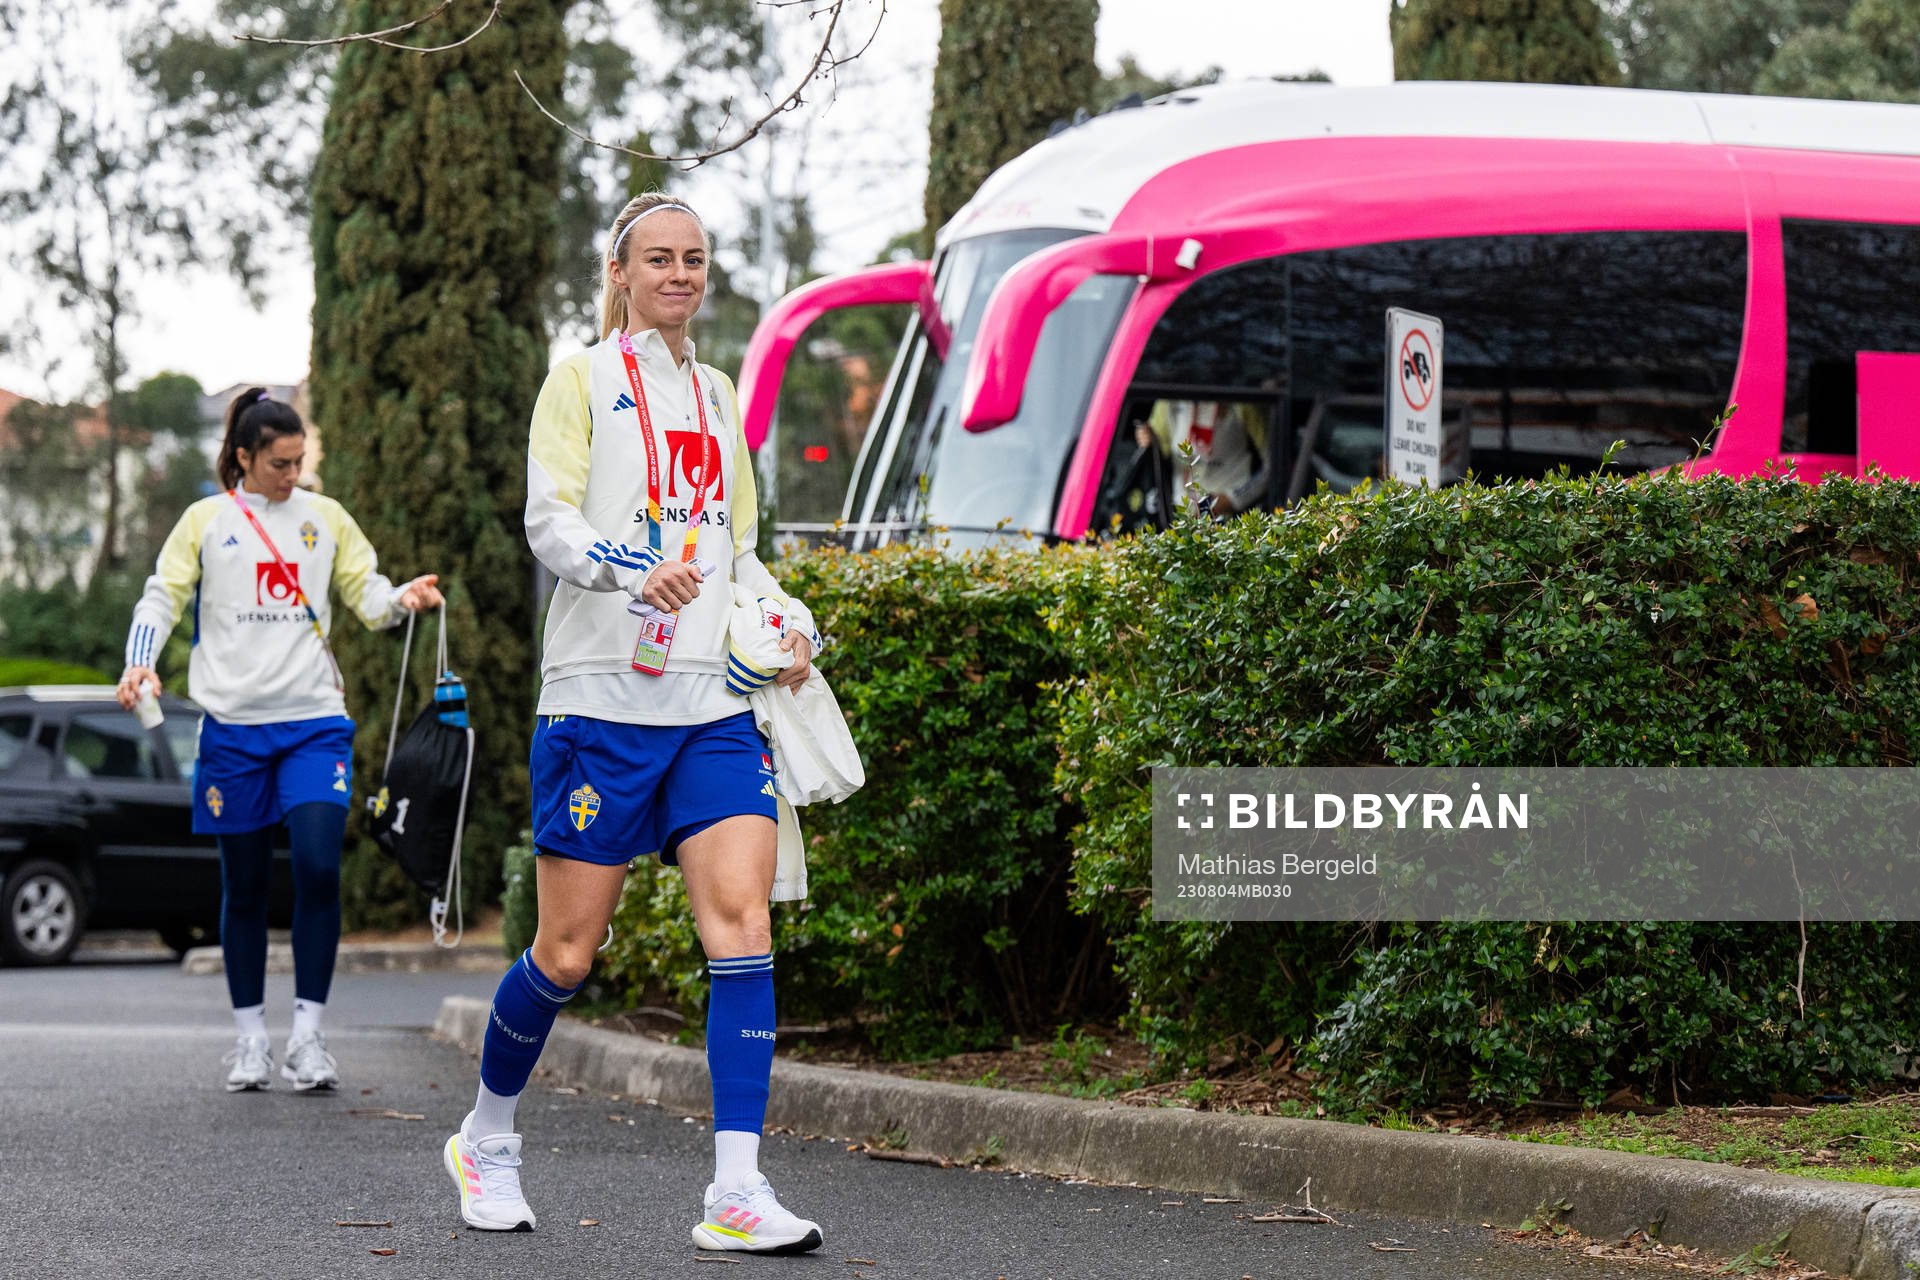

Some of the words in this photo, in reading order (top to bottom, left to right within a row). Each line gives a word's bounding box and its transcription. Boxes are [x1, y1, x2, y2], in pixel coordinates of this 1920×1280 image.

[641, 409, 651, 431] WORLD
[1407, 419, 1415, 431] DO
[1416, 421, 1427, 433] NOT
[1394, 438, 1410, 451] LEAVE
[1412, 441, 1437, 457] CHILDREN
[391, 797, 410, 835] 1
